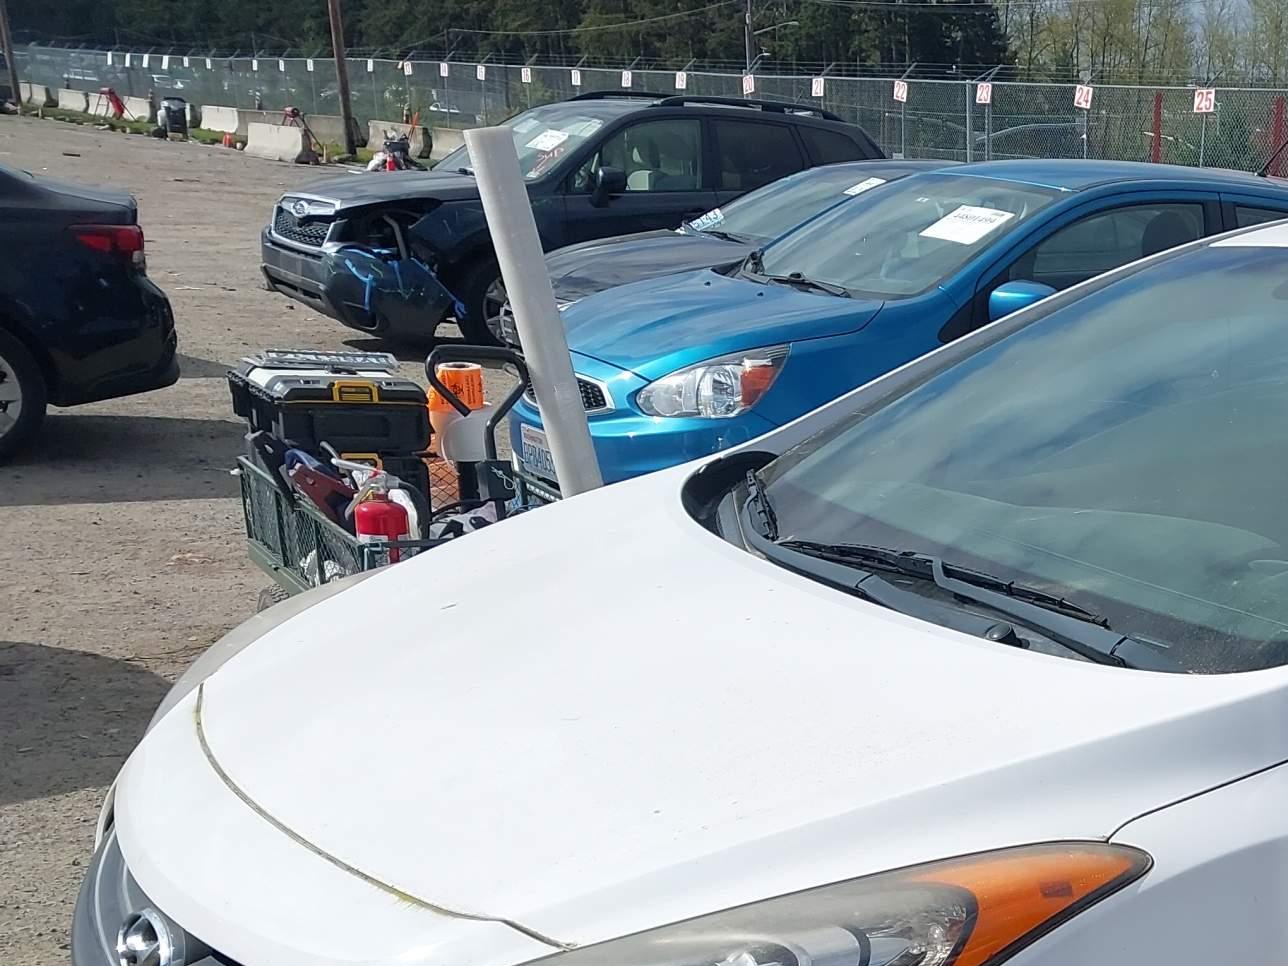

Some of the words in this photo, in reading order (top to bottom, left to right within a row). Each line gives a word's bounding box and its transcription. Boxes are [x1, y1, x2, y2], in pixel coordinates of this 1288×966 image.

[743, 76, 753, 92] 20
[814, 79, 823, 95] 21
[895, 82, 906, 100] 22
[978, 83, 990, 101] 23
[1077, 86, 1090, 106] 24
[1196, 91, 1213, 111] 25
